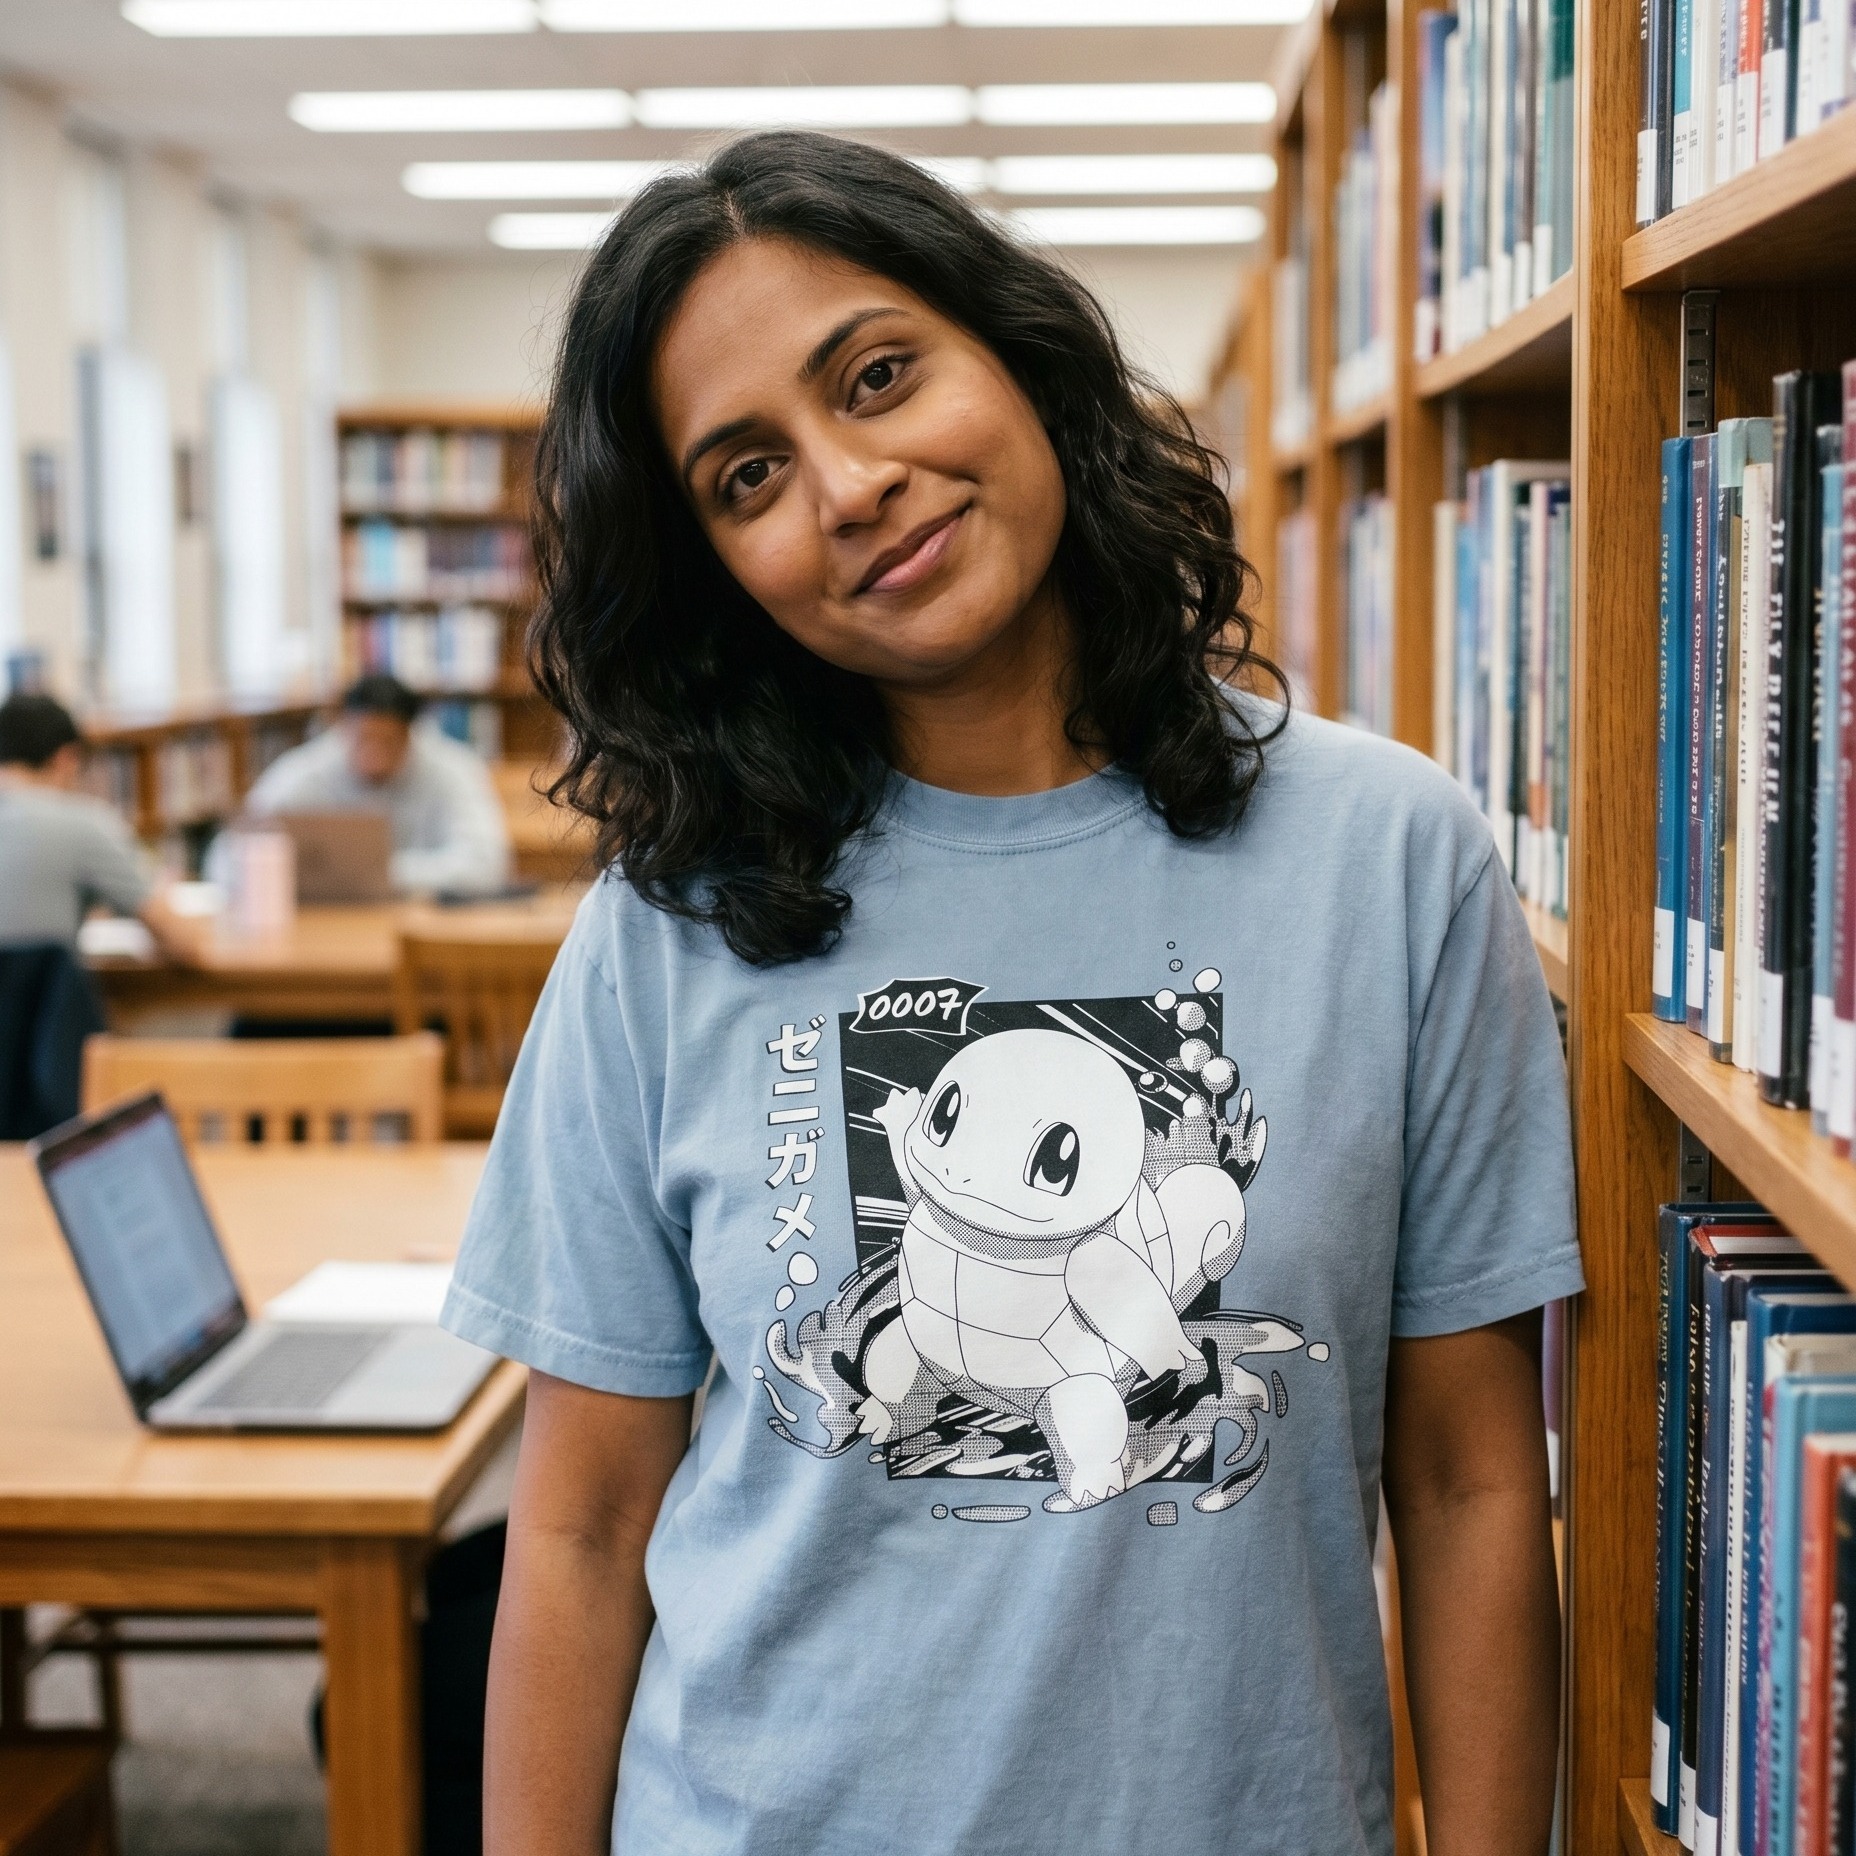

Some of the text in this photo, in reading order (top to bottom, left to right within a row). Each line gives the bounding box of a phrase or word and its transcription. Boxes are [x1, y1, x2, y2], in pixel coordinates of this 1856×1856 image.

[868, 988, 963, 1021] 0007
[765, 1014, 827, 1253] ゼニガメ
